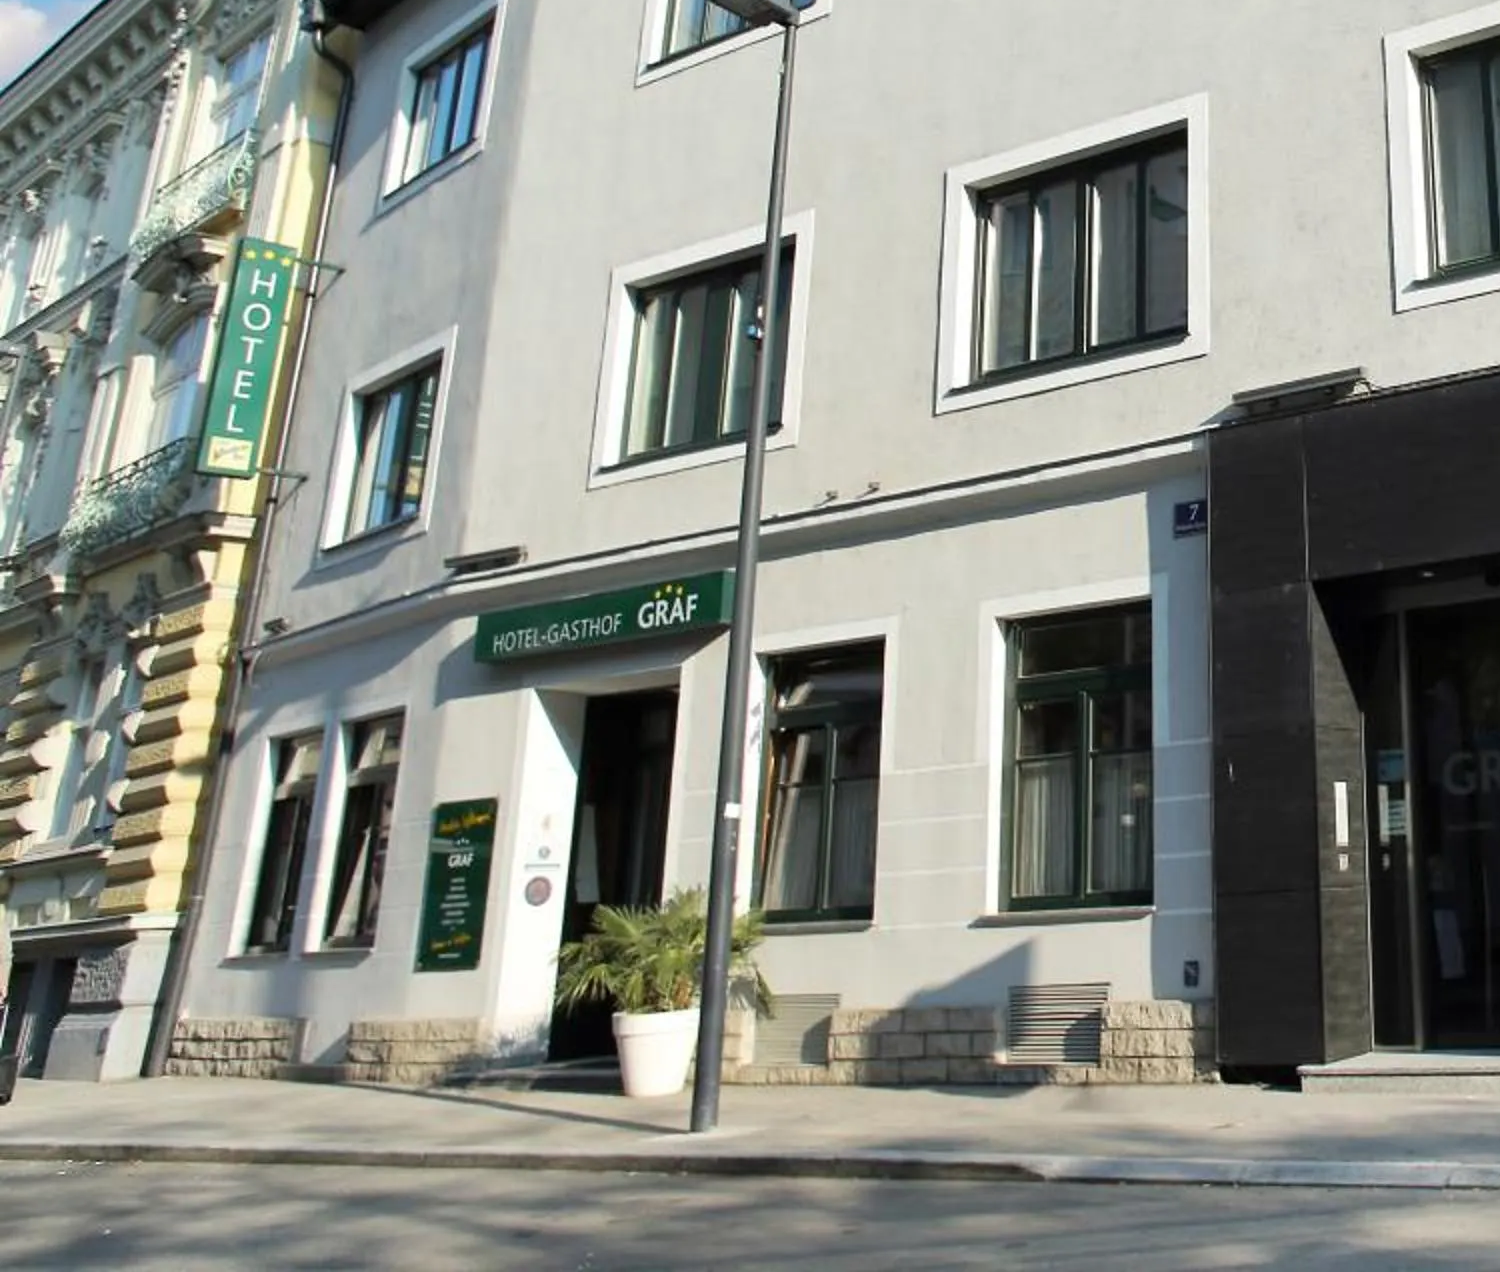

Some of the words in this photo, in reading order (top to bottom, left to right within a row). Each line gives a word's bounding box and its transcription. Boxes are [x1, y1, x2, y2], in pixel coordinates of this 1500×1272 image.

[226, 268, 277, 433] HOTEL
[1189, 503, 1199, 521] 7
[492, 612, 624, 656] HOTEL-GASTHOF
[637, 593, 699, 629] GRAF
